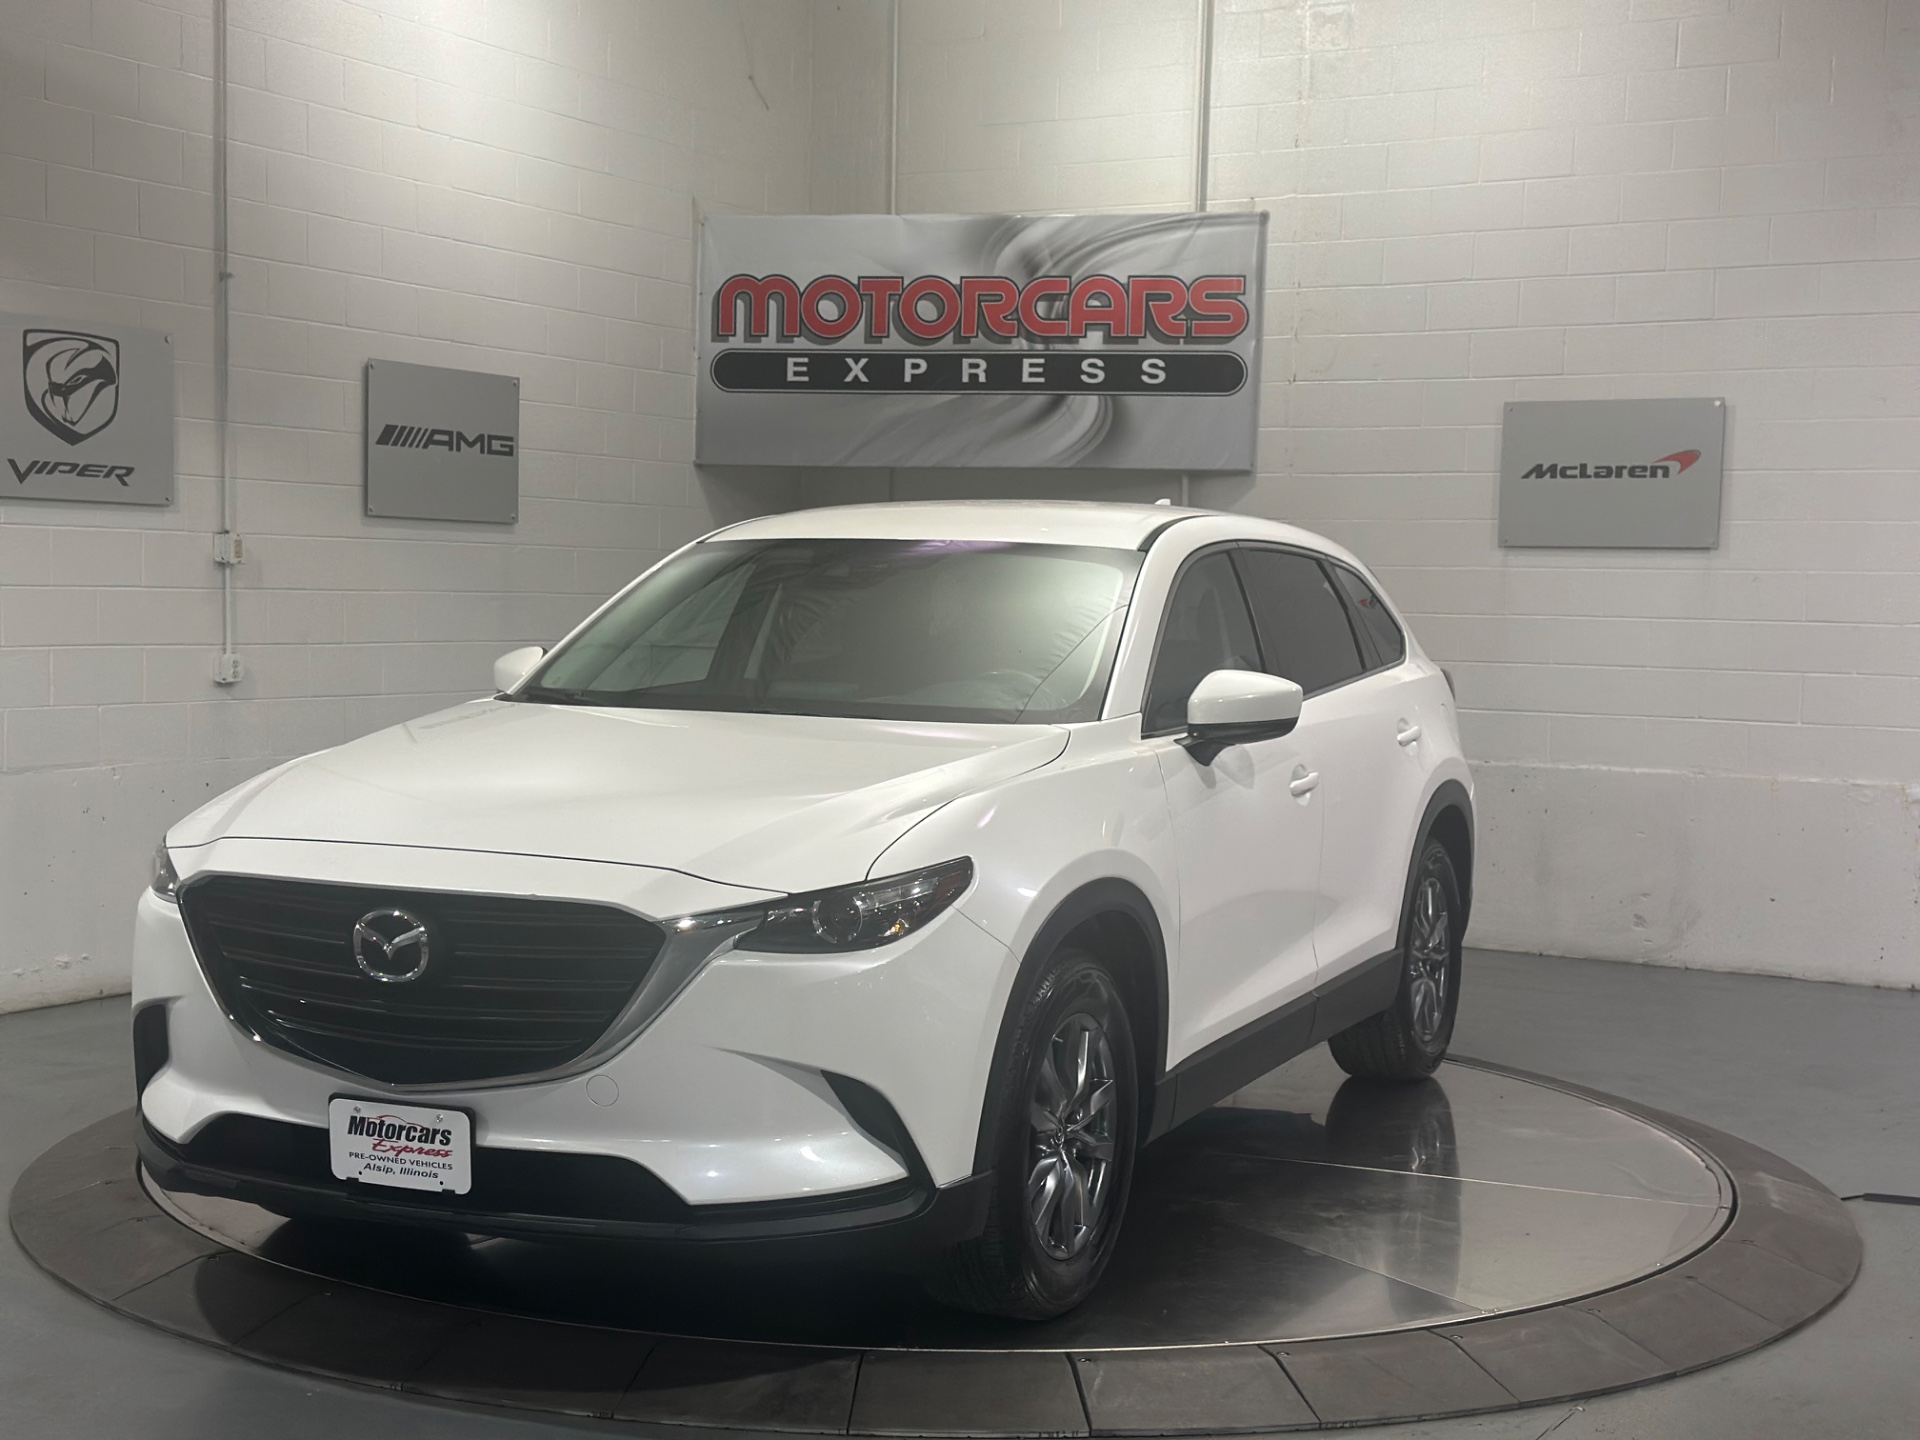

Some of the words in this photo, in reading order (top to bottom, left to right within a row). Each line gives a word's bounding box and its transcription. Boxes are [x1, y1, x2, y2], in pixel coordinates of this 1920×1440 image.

[713, 274, 1249, 345] MOTORCARS
[786, 357, 1166, 384] EXPRESS
[422, 428, 515, 457] AMG
[7, 458, 135, 487] VIPER
[1521, 463, 1670, 479] McLaren
[347, 1115, 452, 1146] Motorcars
[348, 1151, 407, 1165] PRE-OWNED
[409, 1159, 453, 1170] VEHICLES
[372, 1138, 453, 1158] Express
[363, 1162, 396, 1175] Alsip,
[399, 1168, 439, 1179] Illinois
